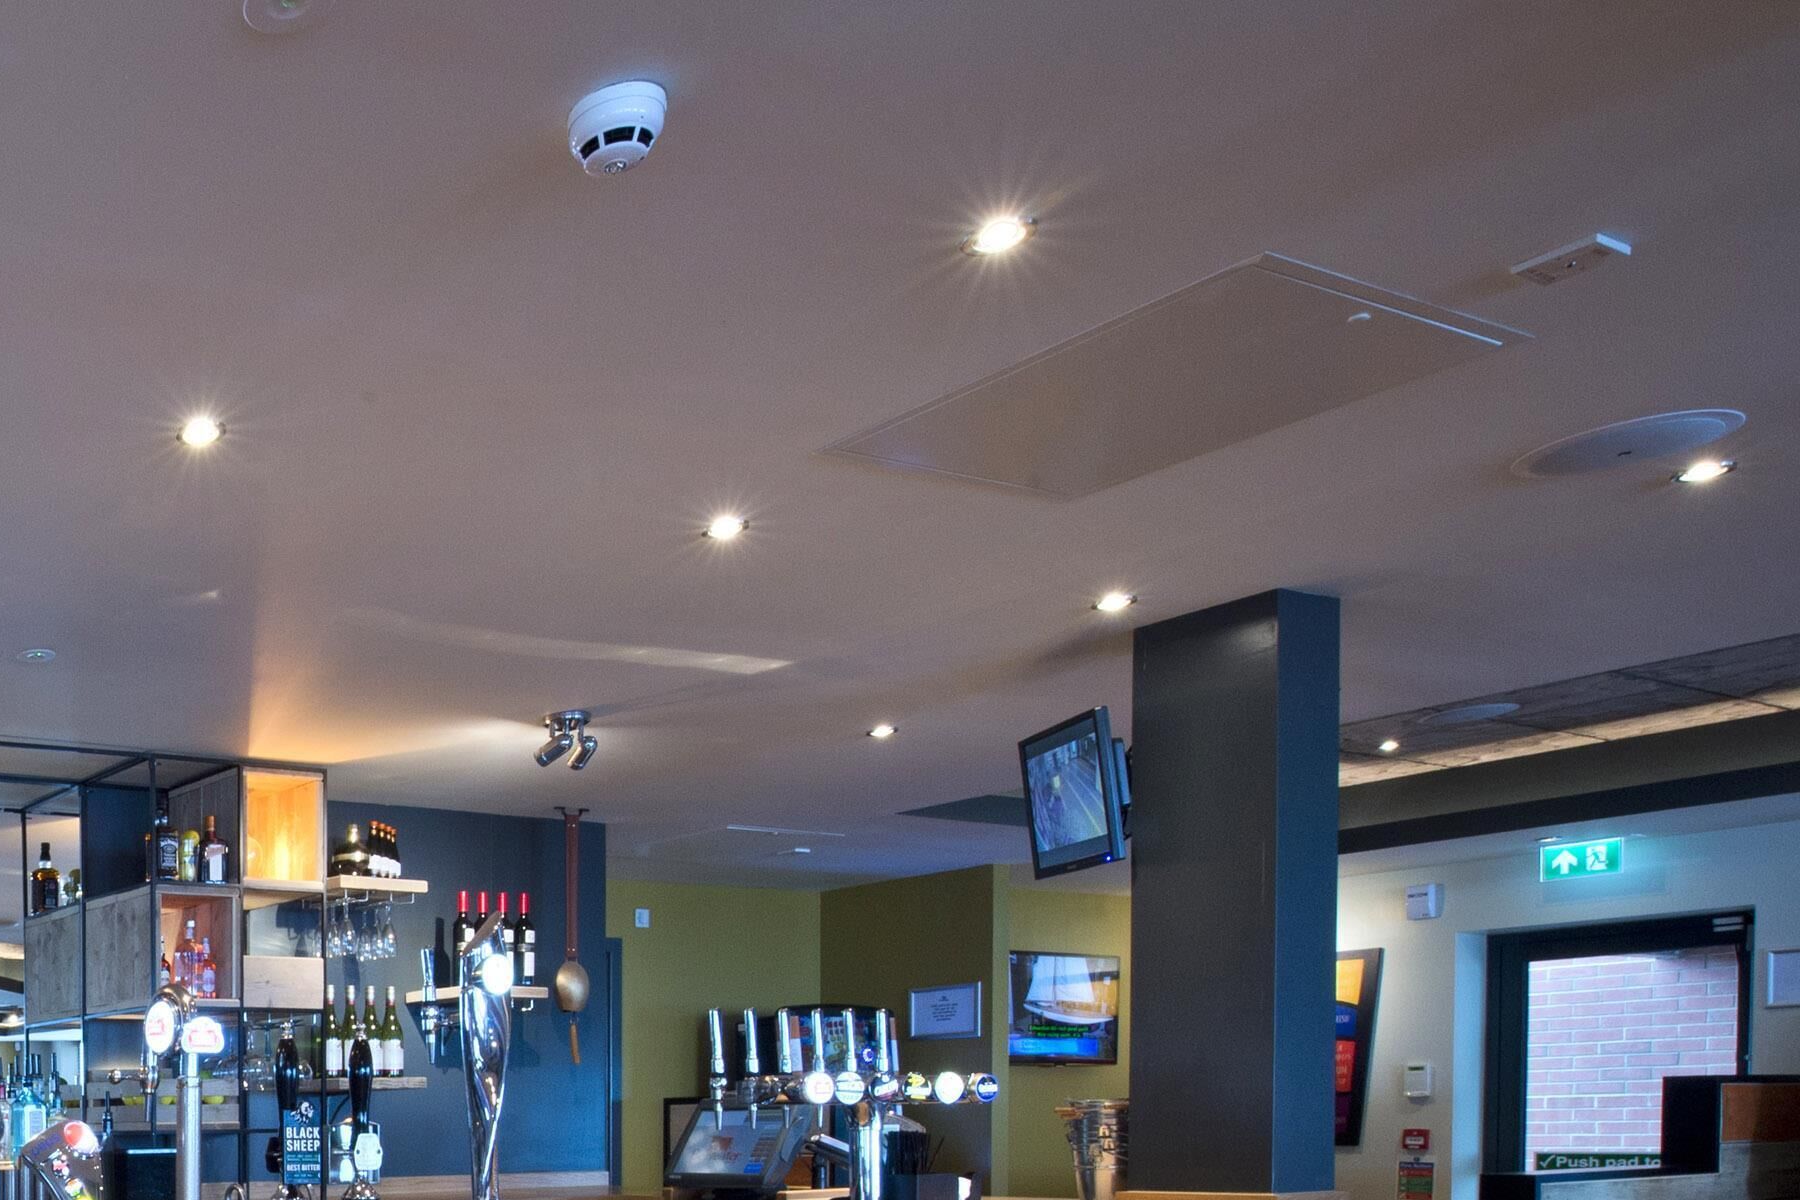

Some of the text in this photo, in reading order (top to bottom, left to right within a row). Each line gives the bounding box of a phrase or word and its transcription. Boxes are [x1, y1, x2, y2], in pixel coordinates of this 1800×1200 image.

[286, 1126, 320, 1139] BLACK
[286, 1139, 321, 1152] SHEEP
[286, 1163, 301, 1172] BEST
[1555, 1156, 1599, 1168] Push
[1604, 1156, 1639, 1168] pad
